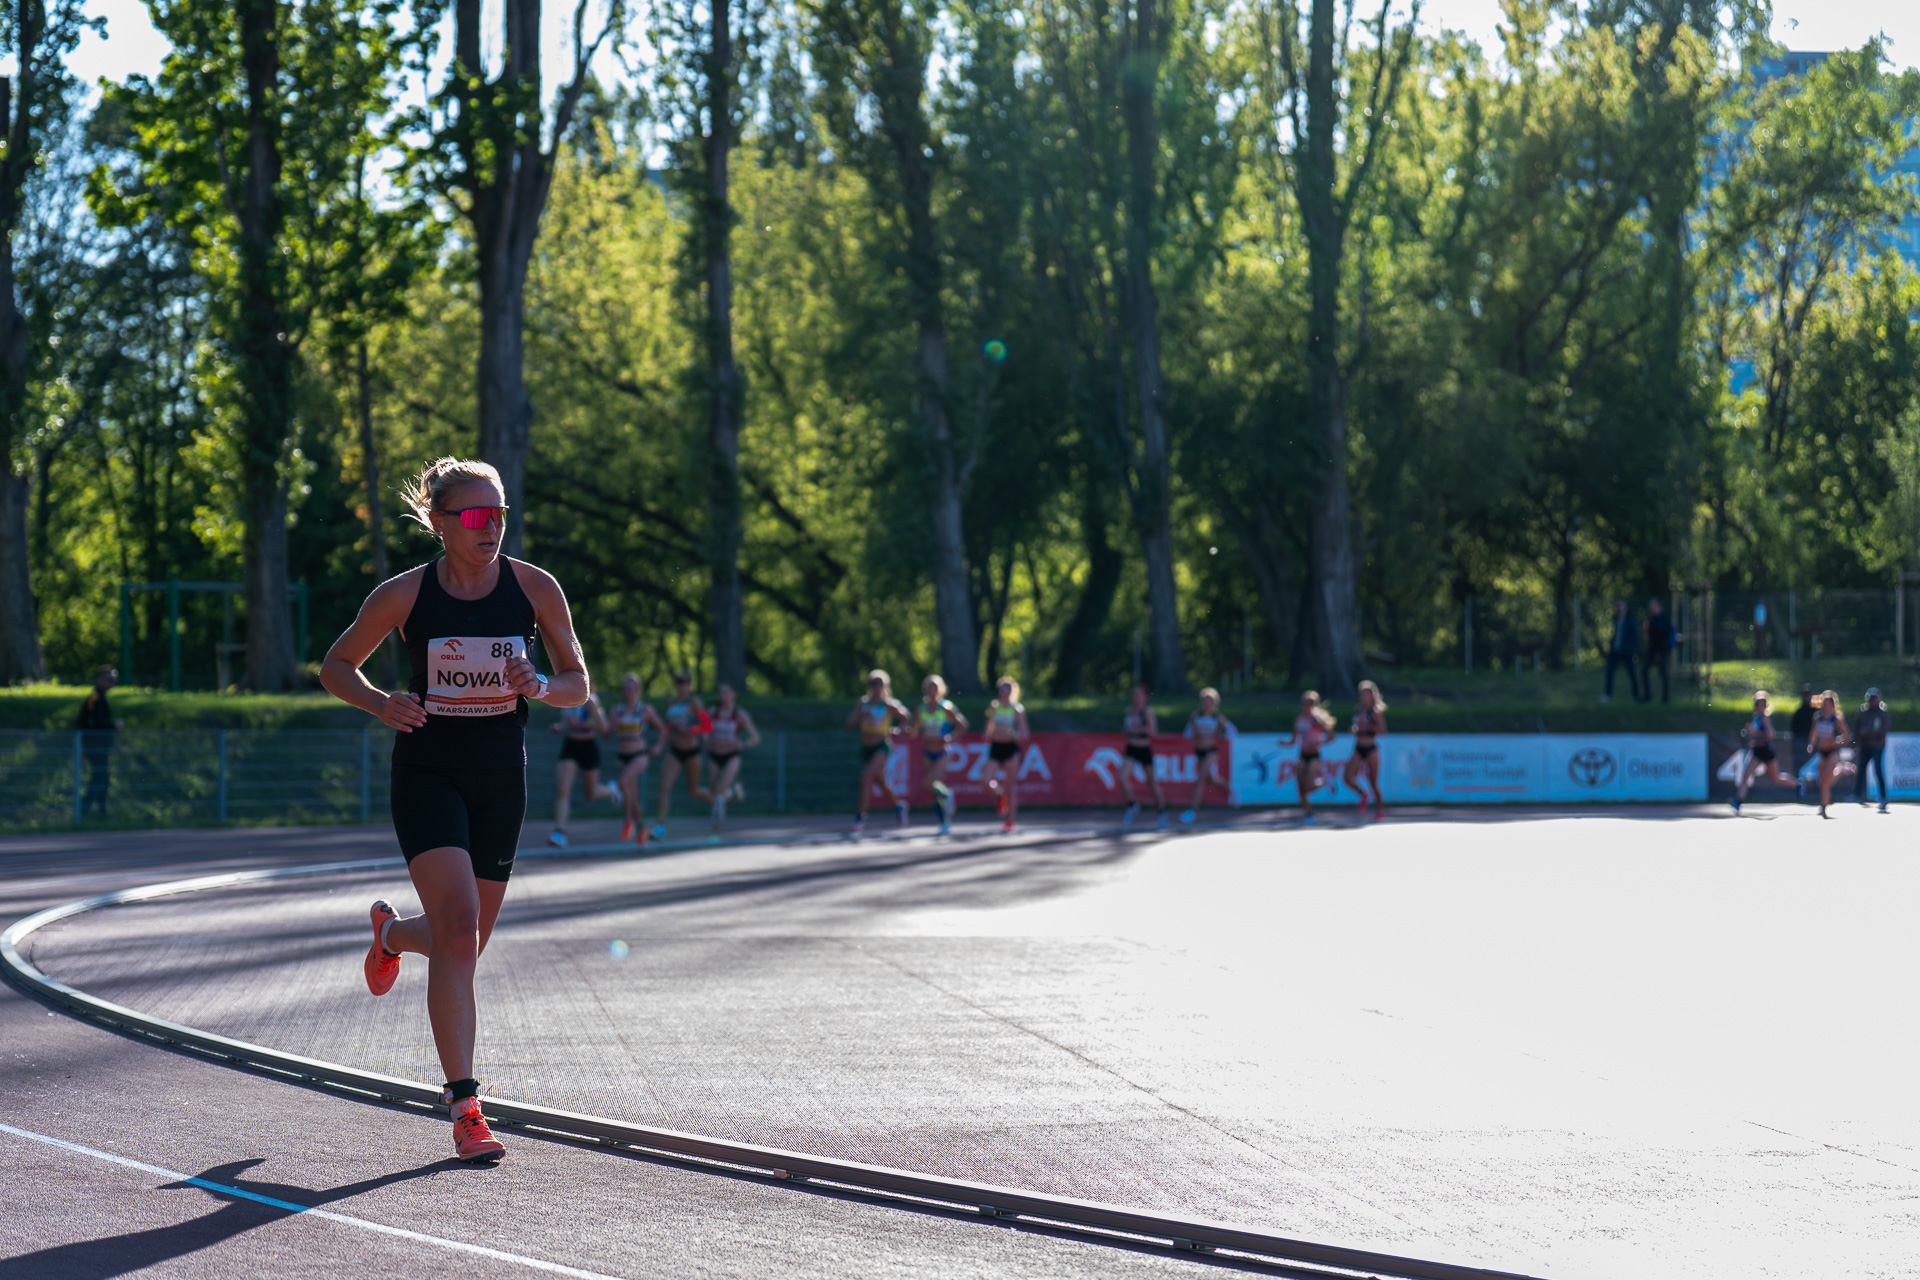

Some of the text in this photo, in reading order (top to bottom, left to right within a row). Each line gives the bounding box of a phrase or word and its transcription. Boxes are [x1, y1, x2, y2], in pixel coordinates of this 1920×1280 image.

[491, 642, 513, 658] 88
[437, 704, 508, 714] WARSZAWA 2025
[944, 743, 1052, 780] PZA
